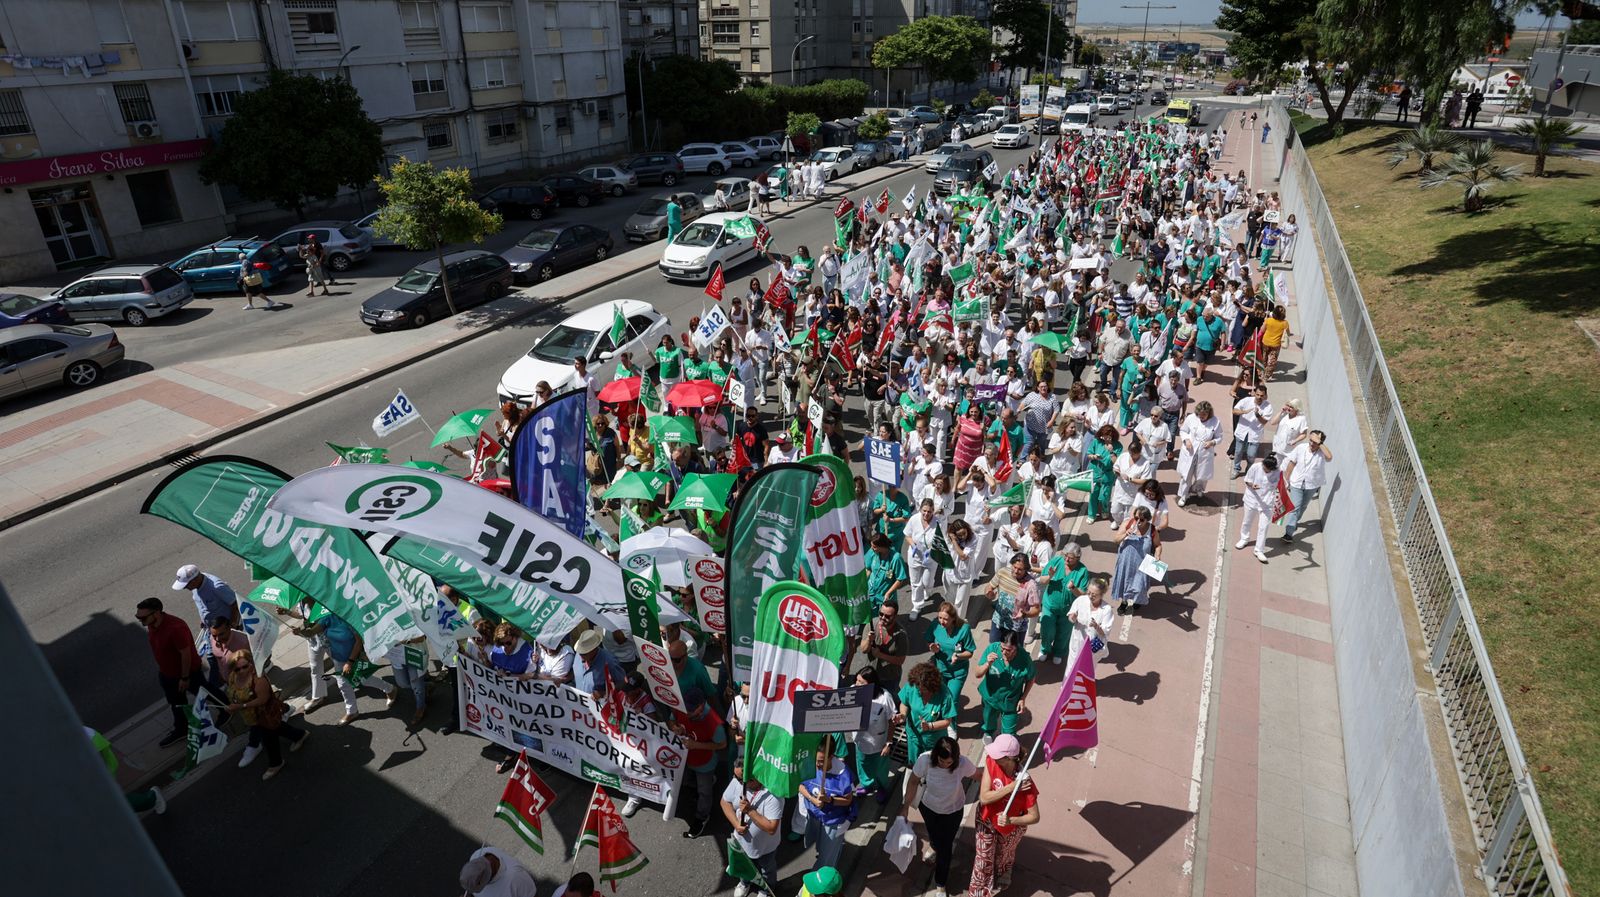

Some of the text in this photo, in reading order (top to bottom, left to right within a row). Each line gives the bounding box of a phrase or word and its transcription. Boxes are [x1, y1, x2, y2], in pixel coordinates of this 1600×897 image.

[49, 151, 145, 179] Irene Silva
[638, 605, 649, 641] CSI
[786, 598, 825, 630] UGT
[473, 662, 560, 700] DEFENSA
[565, 688, 590, 710] DE
[595, 700, 684, 750] NESTRA
[478, 683, 649, 758] SANIDAD PÚBLICA
[508, 713, 555, 737] MÁS
[560, 727, 654, 777] RECORTES
